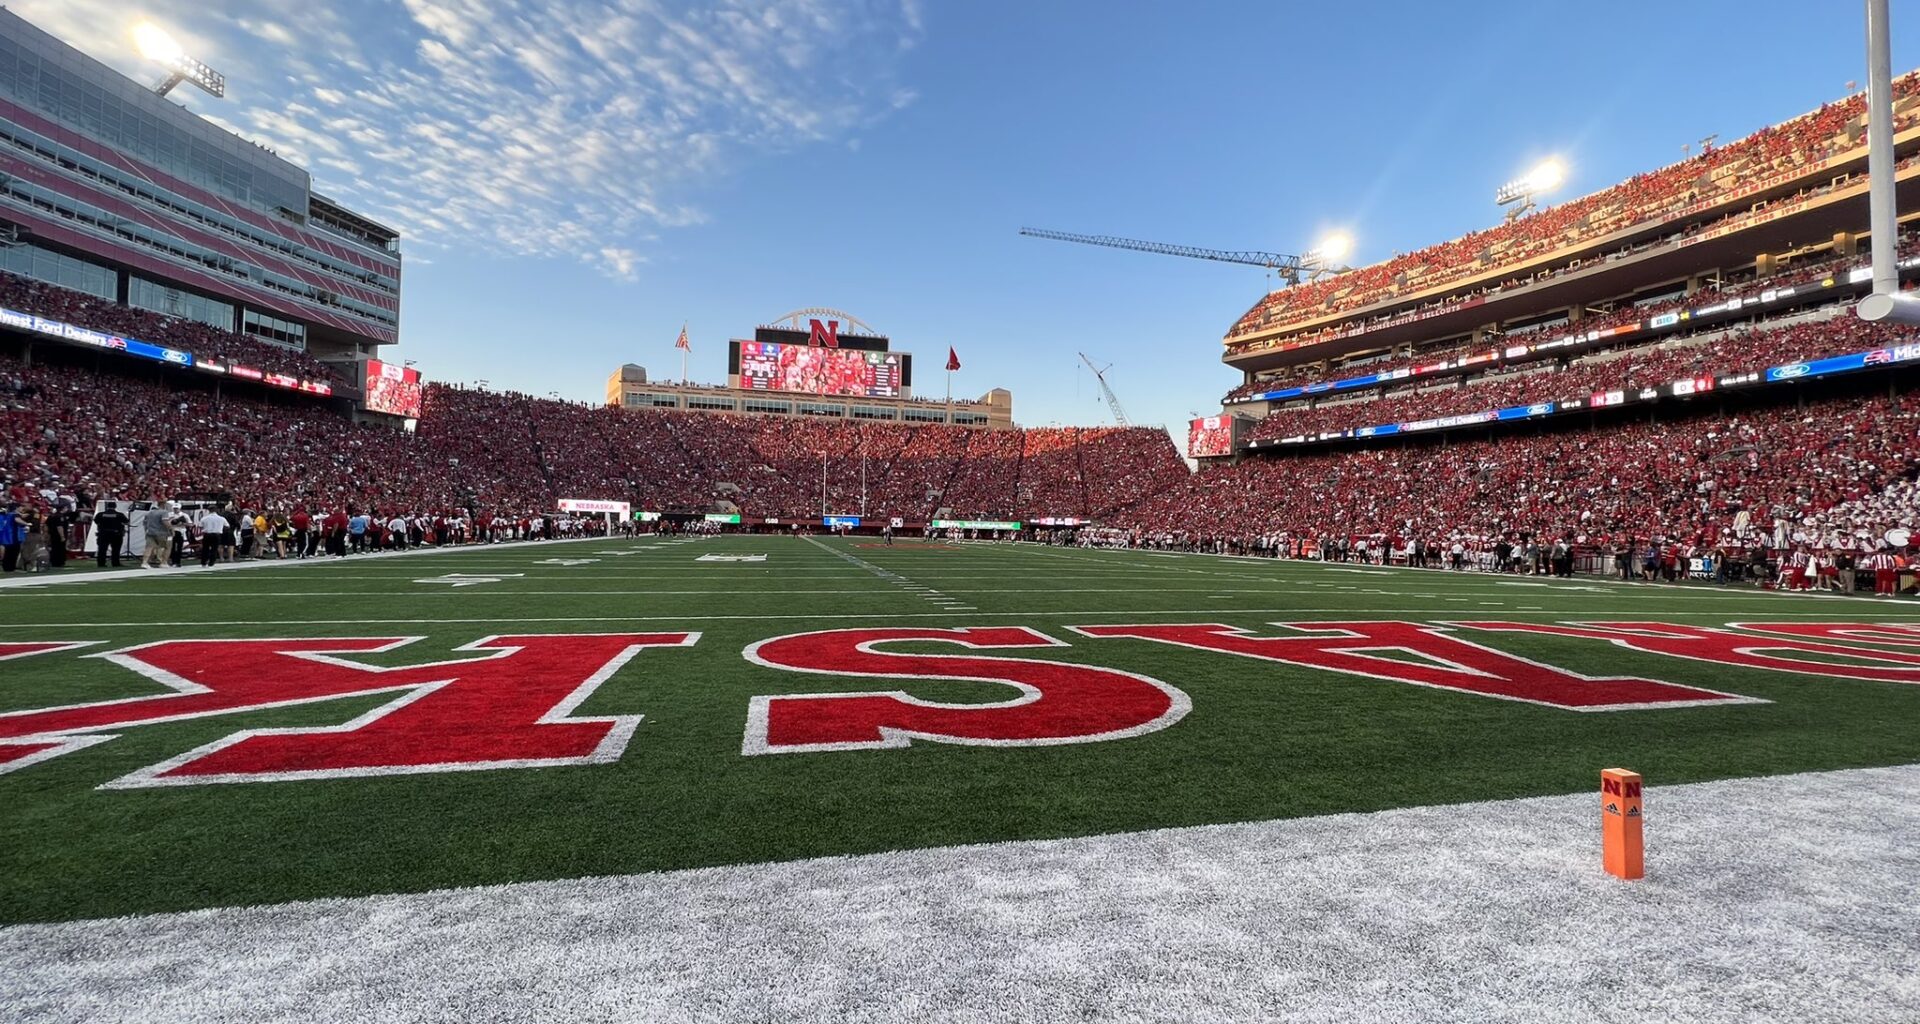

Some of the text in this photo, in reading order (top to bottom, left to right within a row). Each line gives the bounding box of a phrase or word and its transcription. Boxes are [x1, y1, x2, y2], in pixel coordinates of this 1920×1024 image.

[1662, 160, 1828, 222] NATIONAL CHAMPIONSHIPS
[1728, 220, 1749, 232] 1994
[1781, 204, 1802, 215] 1997
[0, 312, 107, 346] west Ford Dealers
[1366, 315, 1419, 333] CONSECUTIVE
[1421, 304, 1462, 321] SELLOUTS
[808, 319, 839, 348] N
[1299, 338, 1318, 347] NCAA
[1319, 332, 1347, 344] RECORD
[1776, 365, 1808, 377] Ford
[1410, 413, 1485, 430] Midwest Ford Dealers
[1603, 778, 1641, 798] N N
